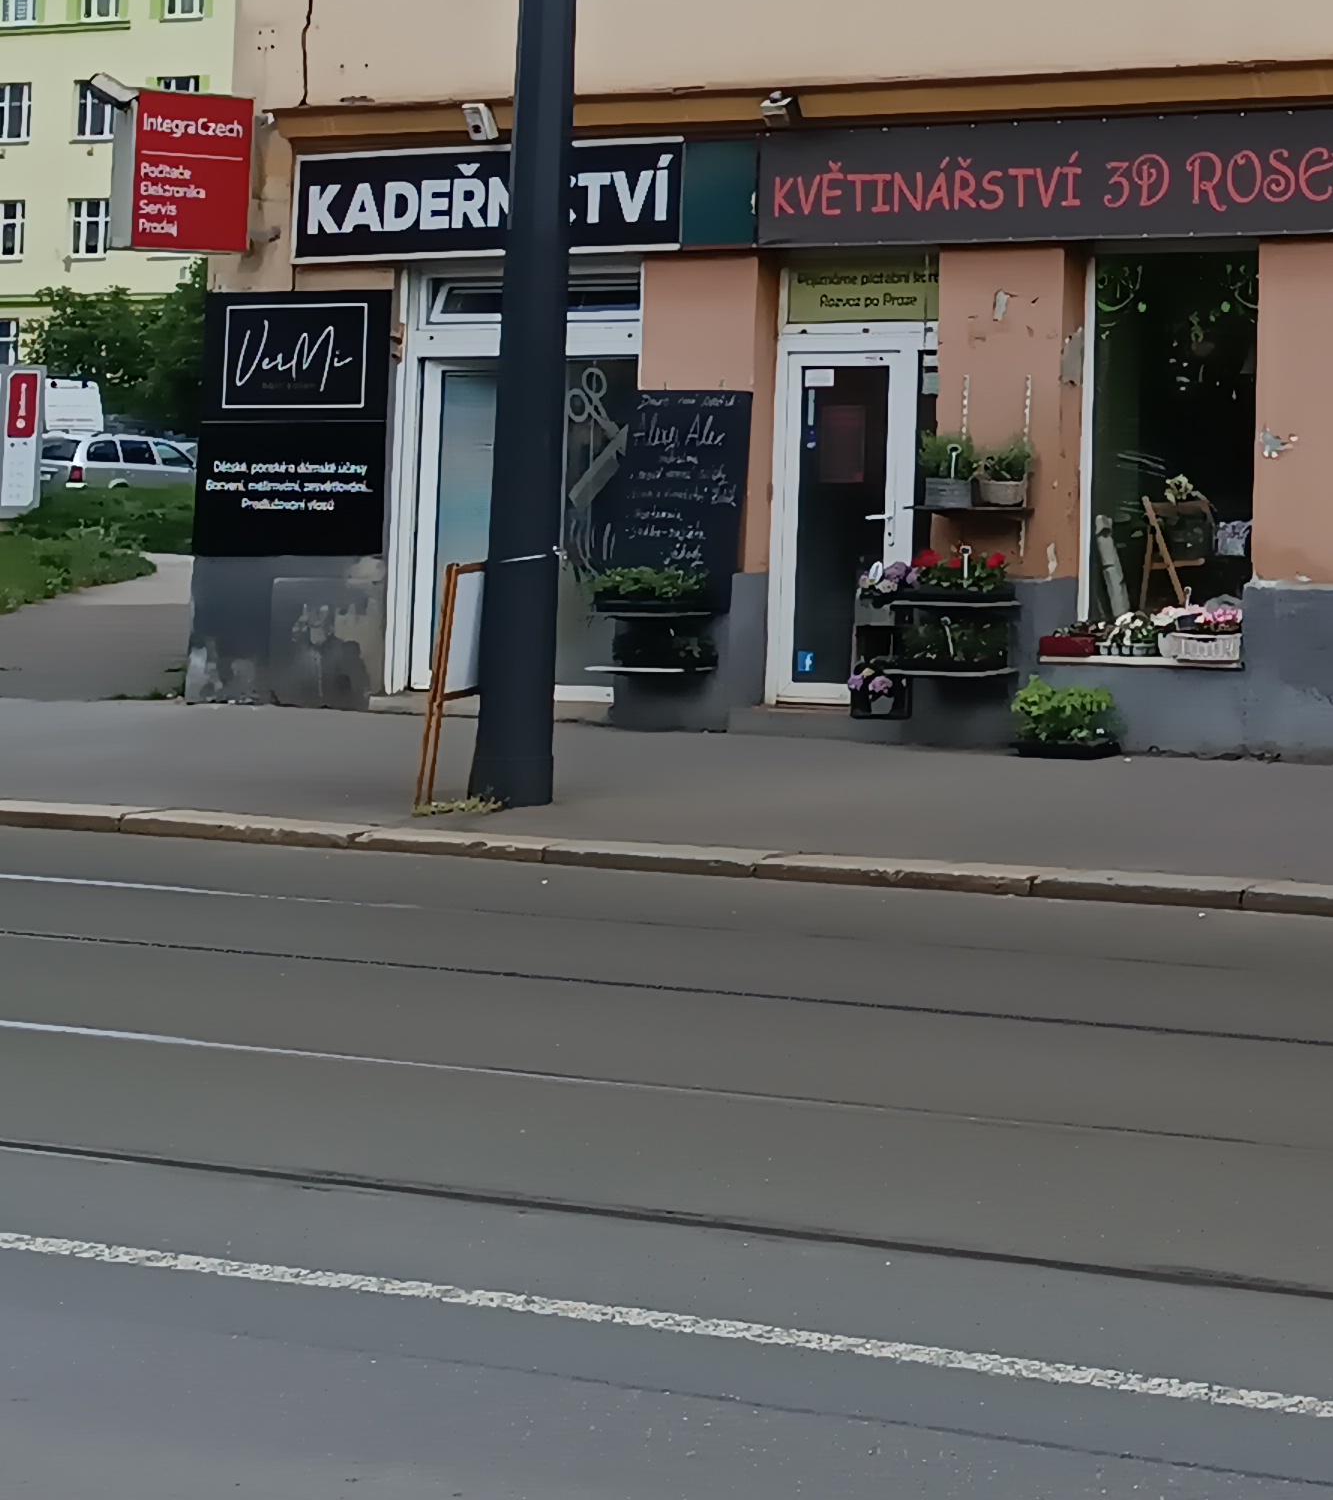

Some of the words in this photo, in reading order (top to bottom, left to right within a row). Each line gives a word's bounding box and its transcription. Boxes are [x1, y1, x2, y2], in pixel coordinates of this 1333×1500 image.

[139, 200, 177, 215] Servis
[306, 154, 674, 235] KADEŘNTVÍ
[773, 152, 1082, 216] KVĚTINÁŘSTVÍ
[1103, 153, 1170, 208] 3D
